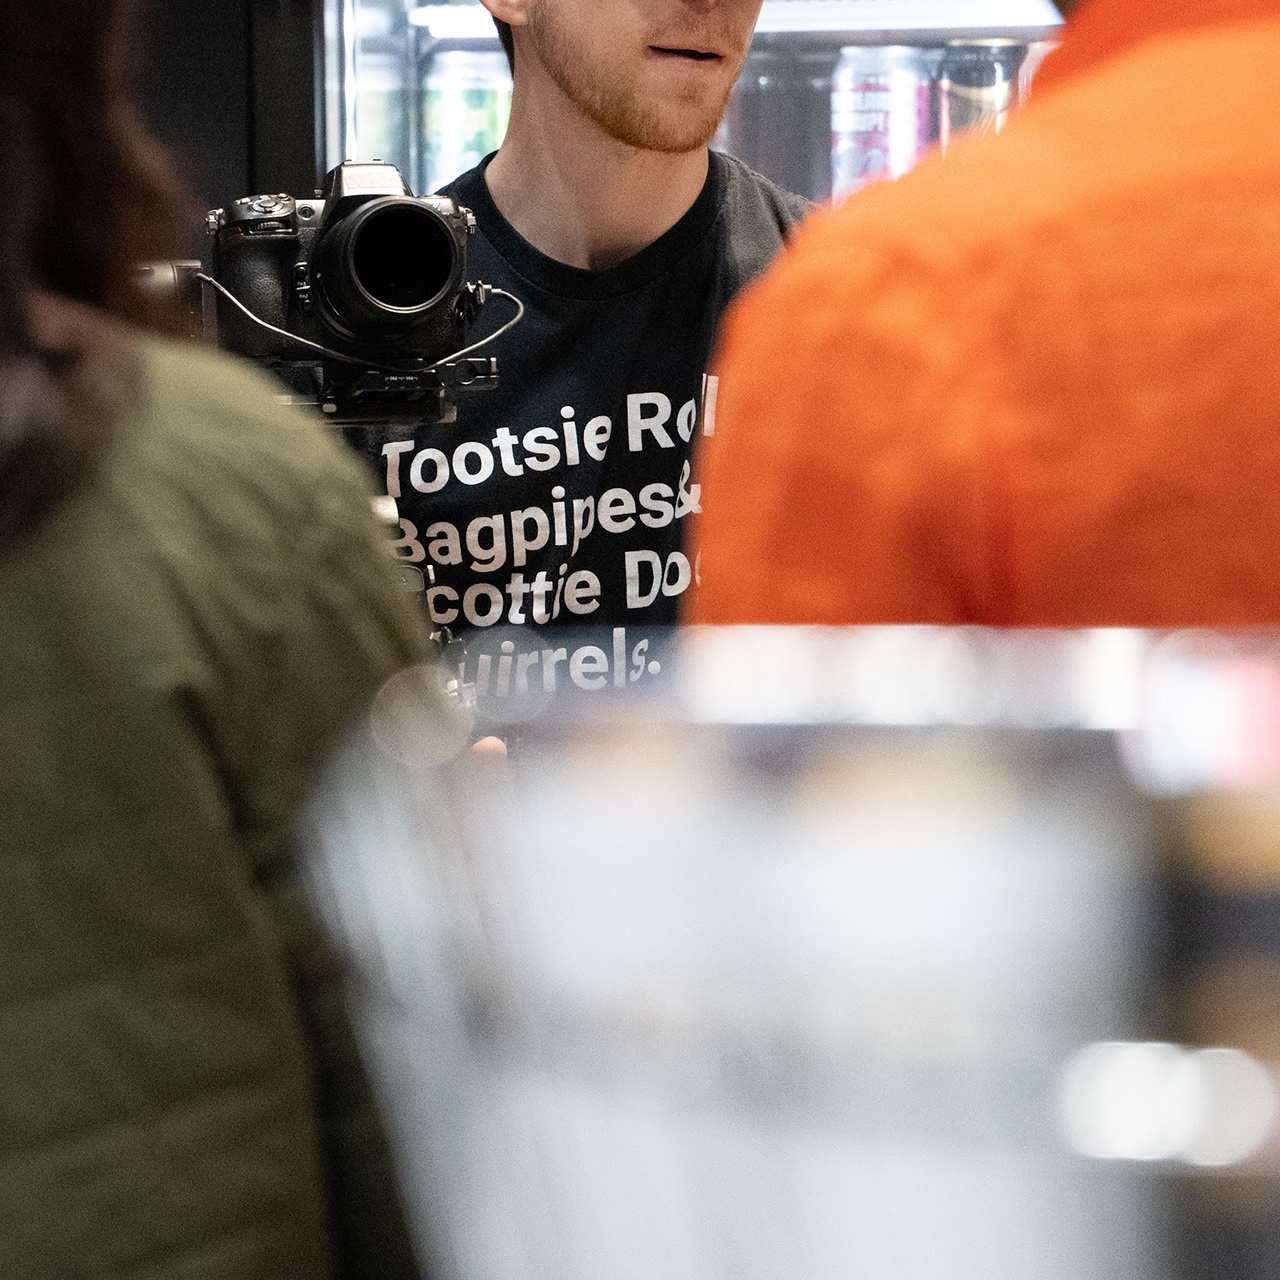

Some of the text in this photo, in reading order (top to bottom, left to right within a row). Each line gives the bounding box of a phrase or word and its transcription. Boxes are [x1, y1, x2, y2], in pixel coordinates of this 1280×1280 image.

[381, 405, 612, 498] Tootsie
[426, 549, 702, 627] cottie Do
